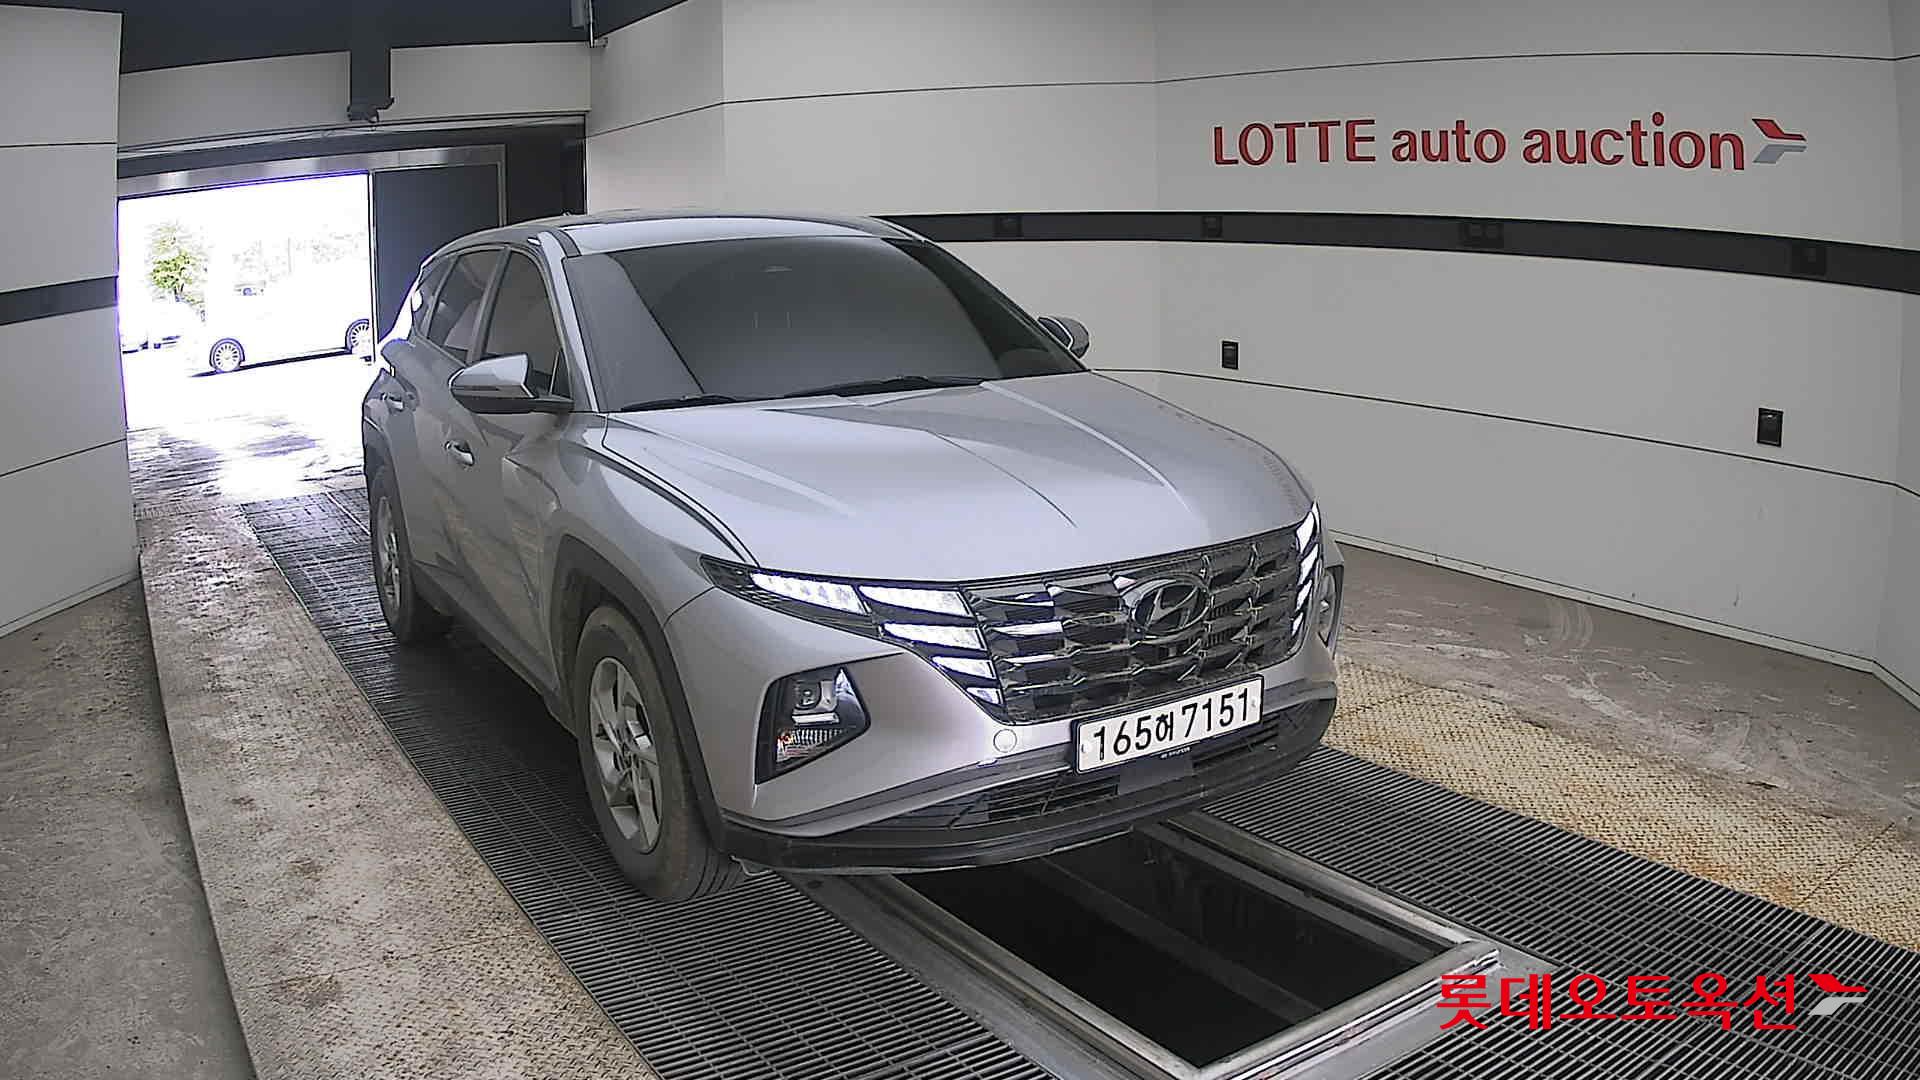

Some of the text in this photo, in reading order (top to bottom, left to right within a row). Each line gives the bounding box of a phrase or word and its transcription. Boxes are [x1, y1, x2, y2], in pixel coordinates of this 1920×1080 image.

[1213, 111, 1746, 171] LOTTE auto auction
[1181, 687, 1248, 738] 7151
